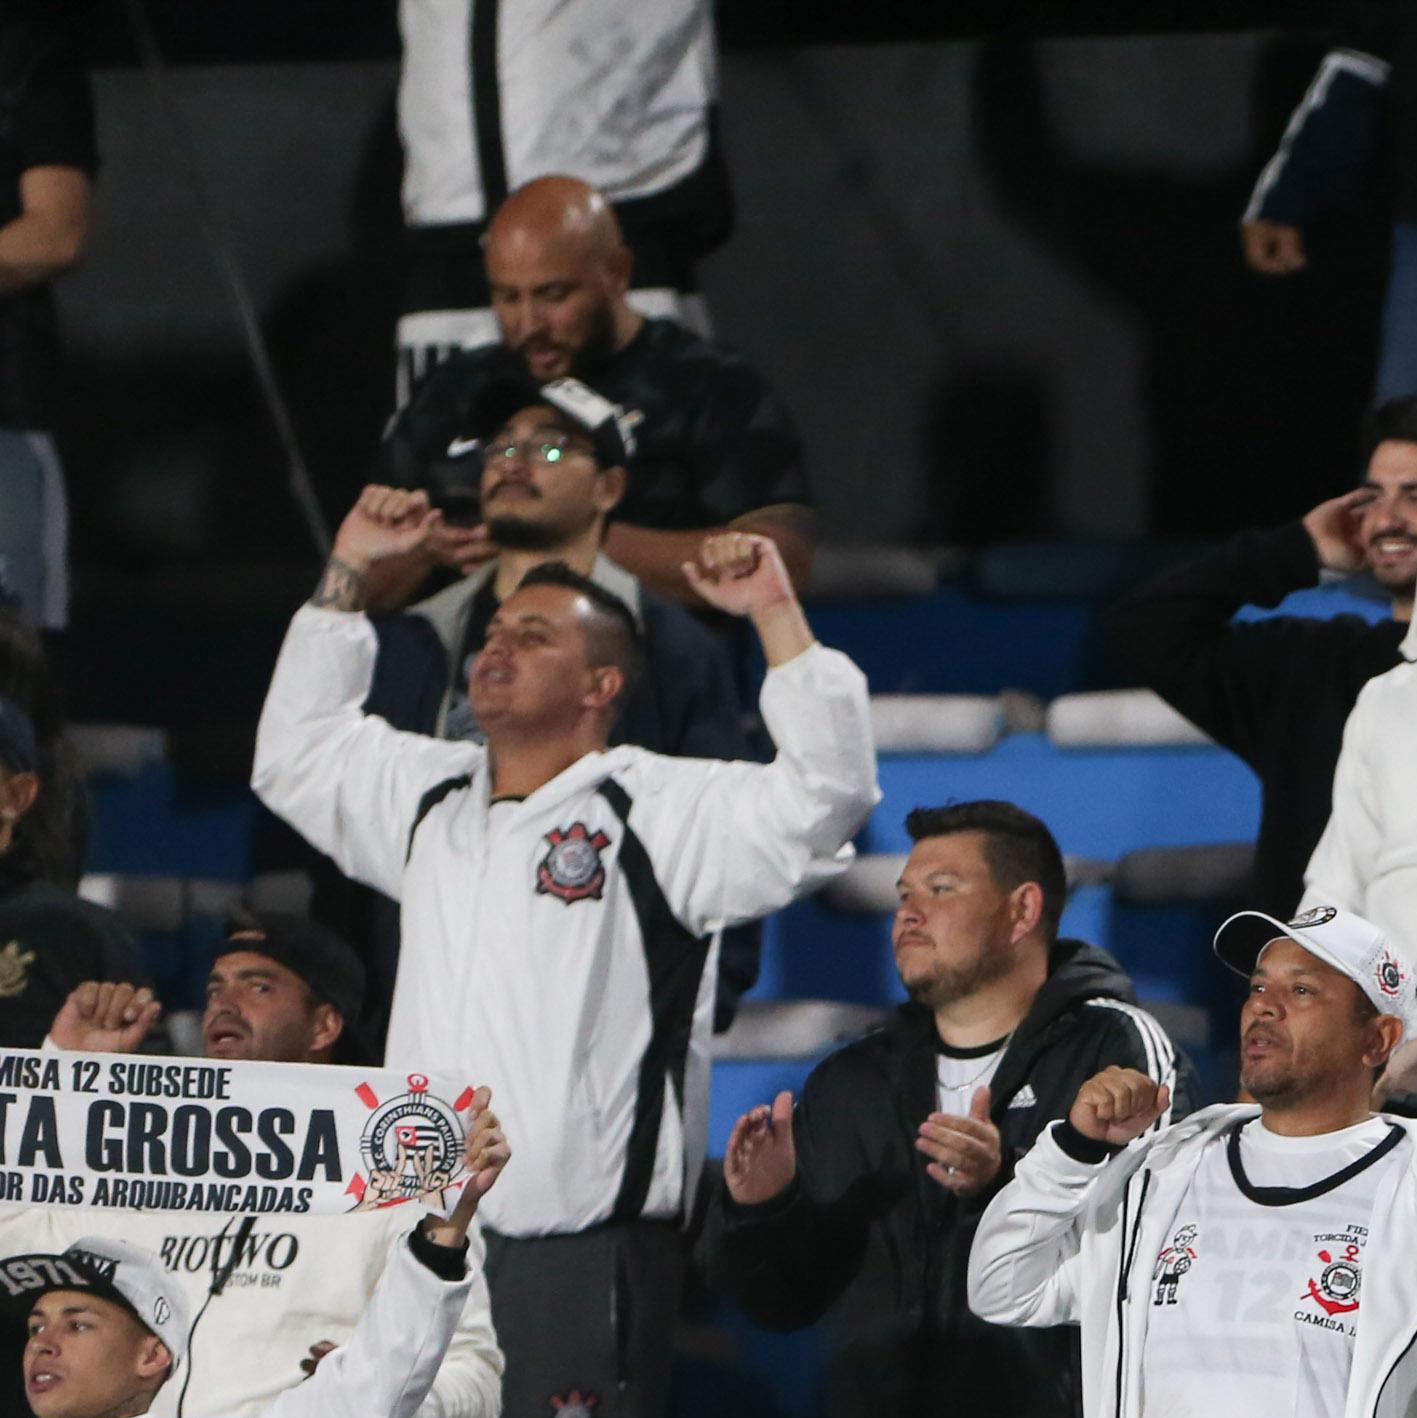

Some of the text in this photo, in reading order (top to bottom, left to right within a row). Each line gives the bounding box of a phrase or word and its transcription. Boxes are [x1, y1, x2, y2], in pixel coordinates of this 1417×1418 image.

[72, 1060, 100, 1092] 12
[109, 1063, 232, 1100] SUBSEDE
[85, 1099, 342, 1182] GROSSA
[374, 1104, 438, 1144] CORINTHIANS
[437, 1117, 457, 1170] PAULISTA
[32, 1173, 84, 1205] DAS
[90, 1178, 313, 1213] ARQUIBANCADAS
[1314, 1233, 1360, 1245] TORCIDA
[1346, 1224, 1368, 1236] FIE
[0, 1258, 89, 1296] 1971
[1294, 1311, 1345, 1333] CAMISA
